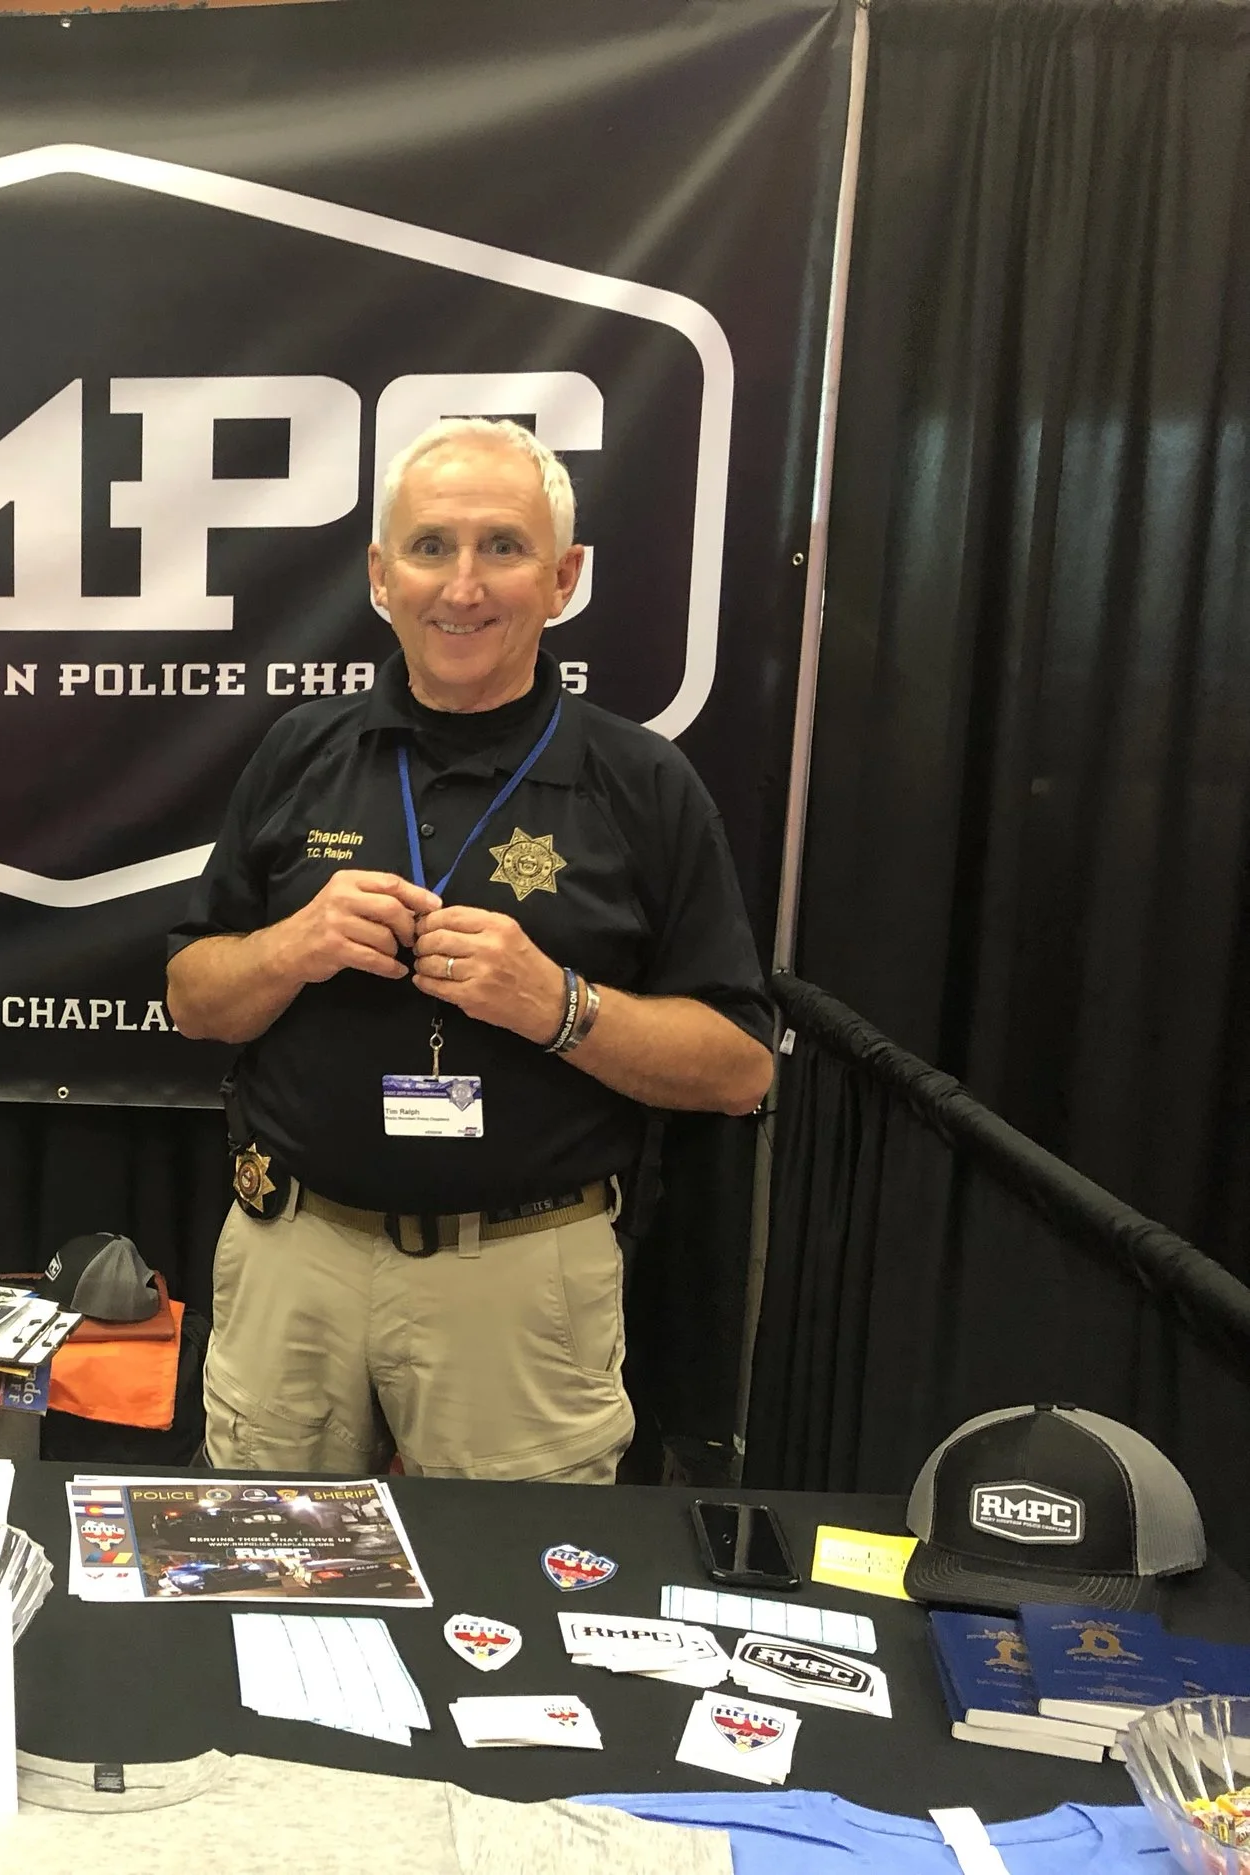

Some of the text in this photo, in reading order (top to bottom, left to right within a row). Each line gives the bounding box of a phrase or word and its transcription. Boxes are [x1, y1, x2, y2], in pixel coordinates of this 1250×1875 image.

[58, 662, 246, 696] POLICE
[307, 829, 363, 846] Chaplain
[324, 847, 353, 860] Ralph
[570, 990, 578, 1004] NO
[566, 1004, 577, 1023] ONE
[399, 1108, 420, 1116] Ralph
[133, 1489, 377, 1501] POLICE SHERIFF
[980, 1494, 1072, 1528] RMPC
[582, 1626, 673, 1643] RMPC
[756, 1648, 855, 1682] RMPC
